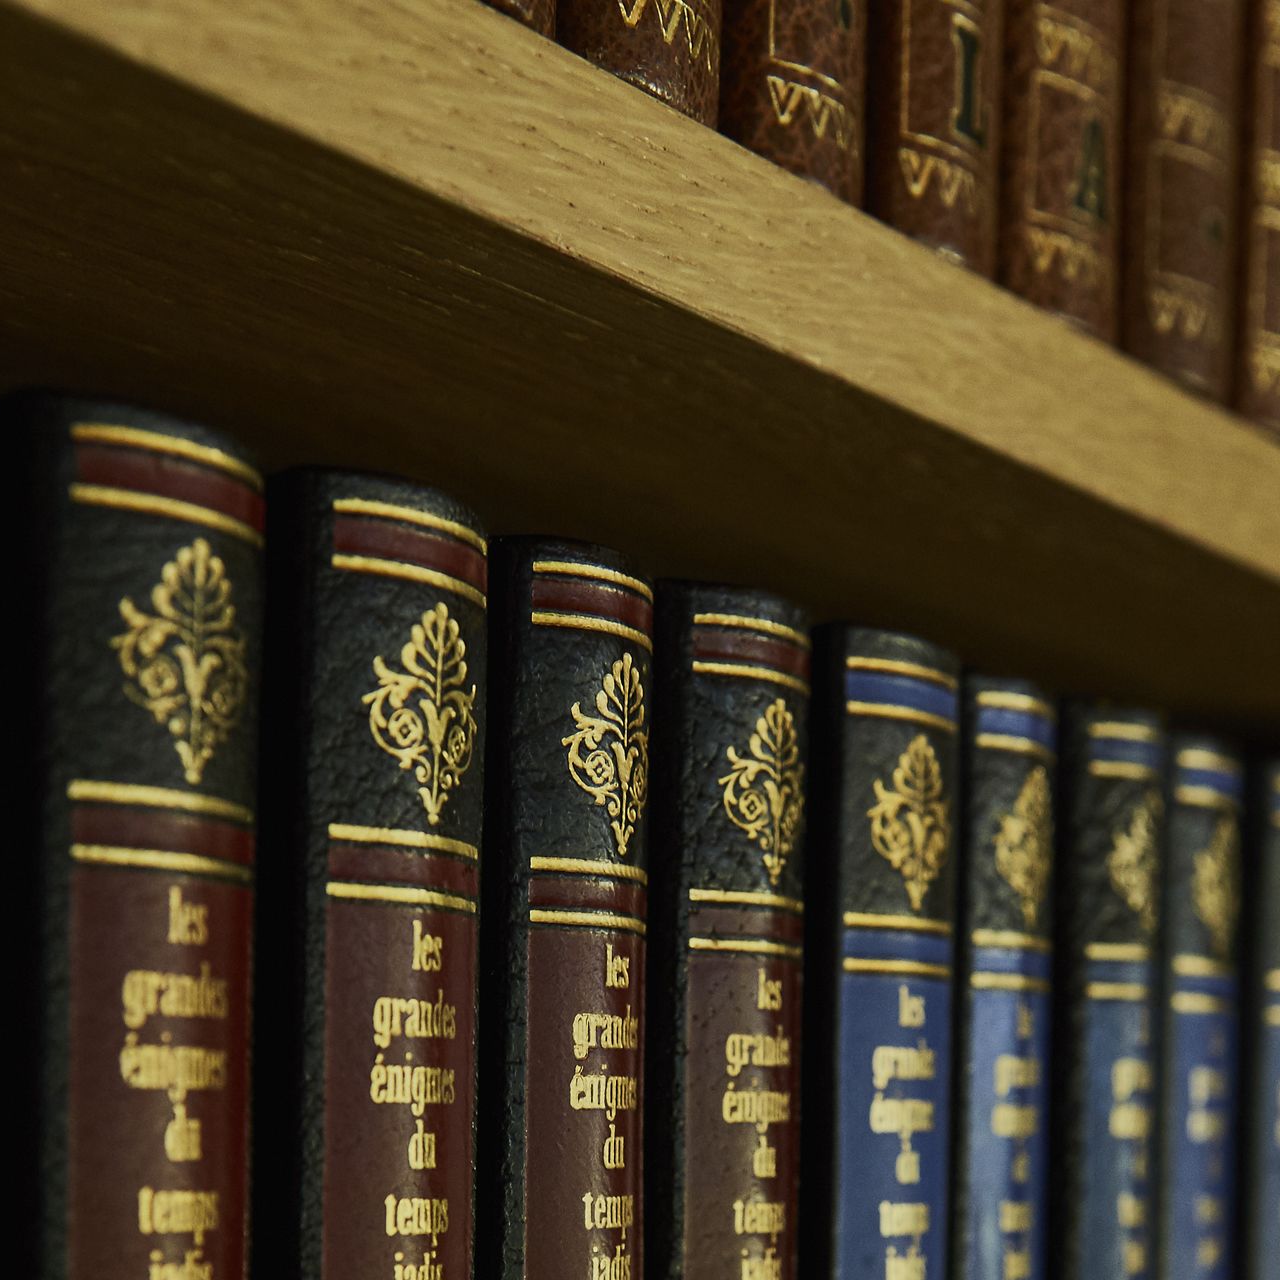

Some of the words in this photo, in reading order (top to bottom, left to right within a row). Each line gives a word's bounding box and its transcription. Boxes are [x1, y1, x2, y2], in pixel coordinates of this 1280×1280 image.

[168, 885, 208, 944] les
[412, 919, 443, 971] les
[606, 943, 629, 988] les
[122, 961, 228, 1029] grandes
[757, 968, 782, 1010] les
[373, 989, 456, 1049] grandes
[572, 1004, 638, 1060] grandes
[119, 1031, 227, 1103] énigmes
[725, 1025, 790, 1076] grandes
[370, 1053, 455, 1117] énigmes
[569, 1064, 637, 1121] énigmes
[165, 1103, 202, 1162] du
[408, 1119, 436, 1170] du
[604, 1123, 625, 1169] du
[753, 1135, 776, 1178] du
[138, 1186, 217, 1246] temps
[384, 1194, 449, 1247] temps
[582, 1191, 633, 1239] temps
